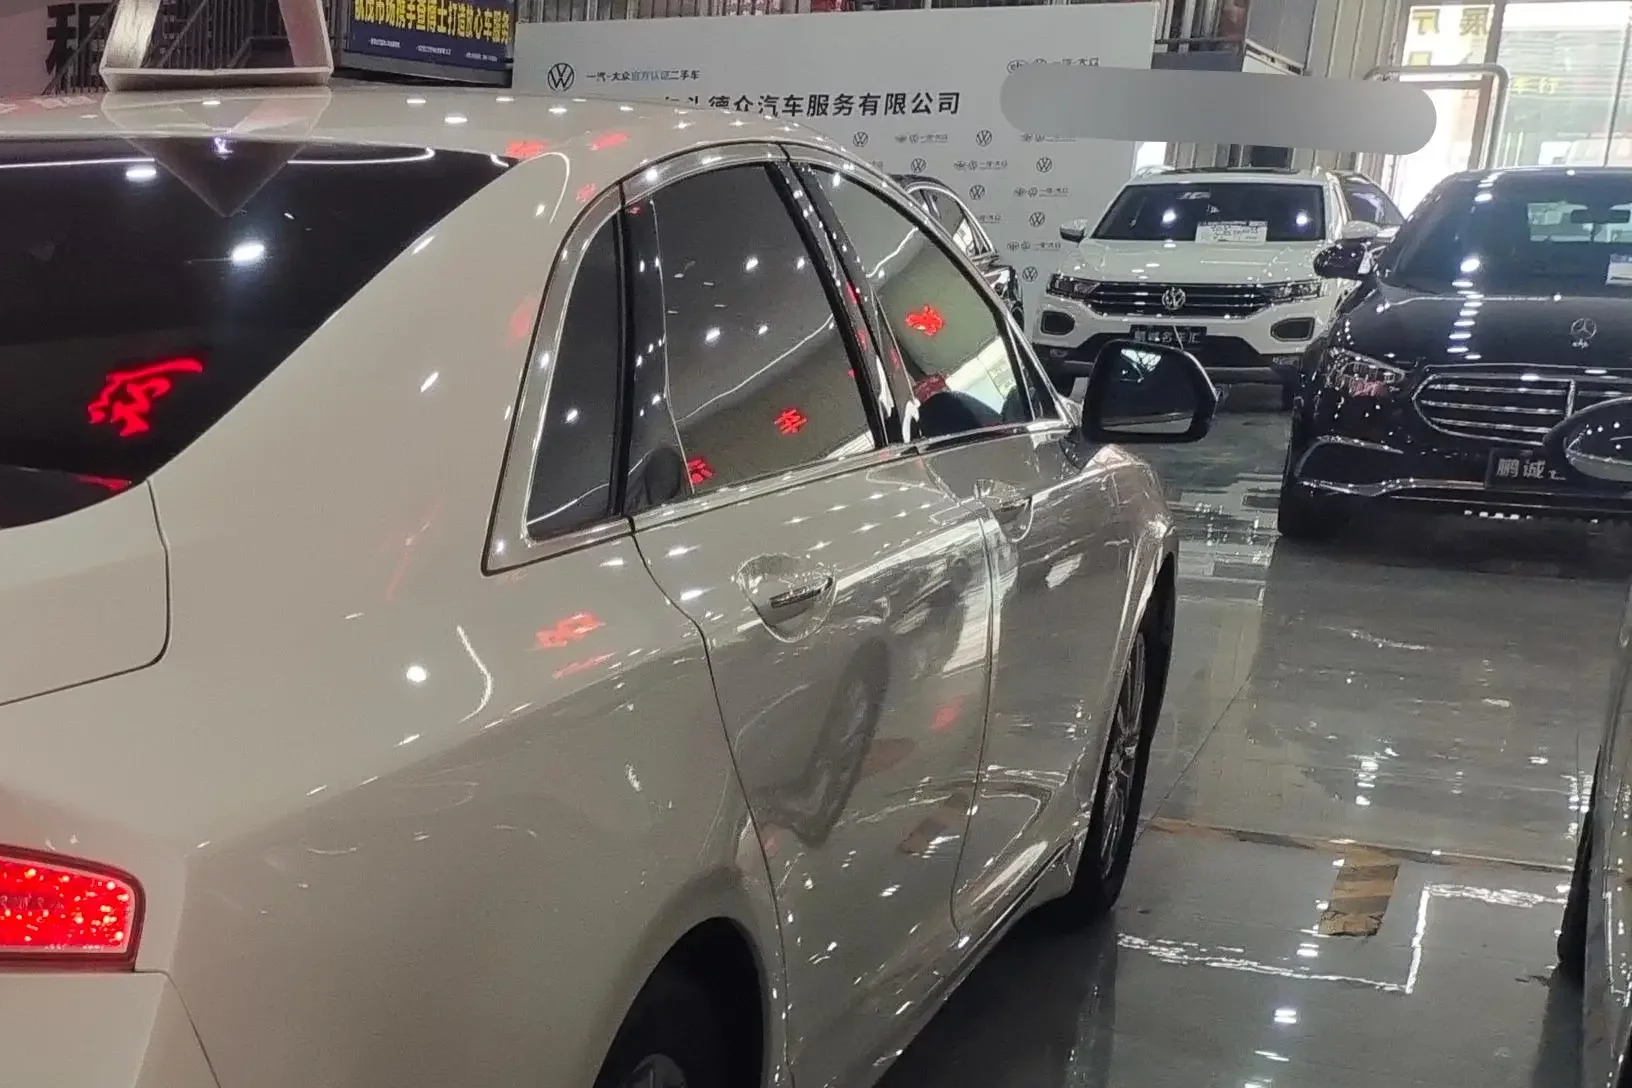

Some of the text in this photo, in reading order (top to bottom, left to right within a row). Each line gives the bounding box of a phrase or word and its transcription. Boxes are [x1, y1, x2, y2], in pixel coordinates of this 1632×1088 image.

[665, 91, 961, 118] 德众汽车服务有限公司
